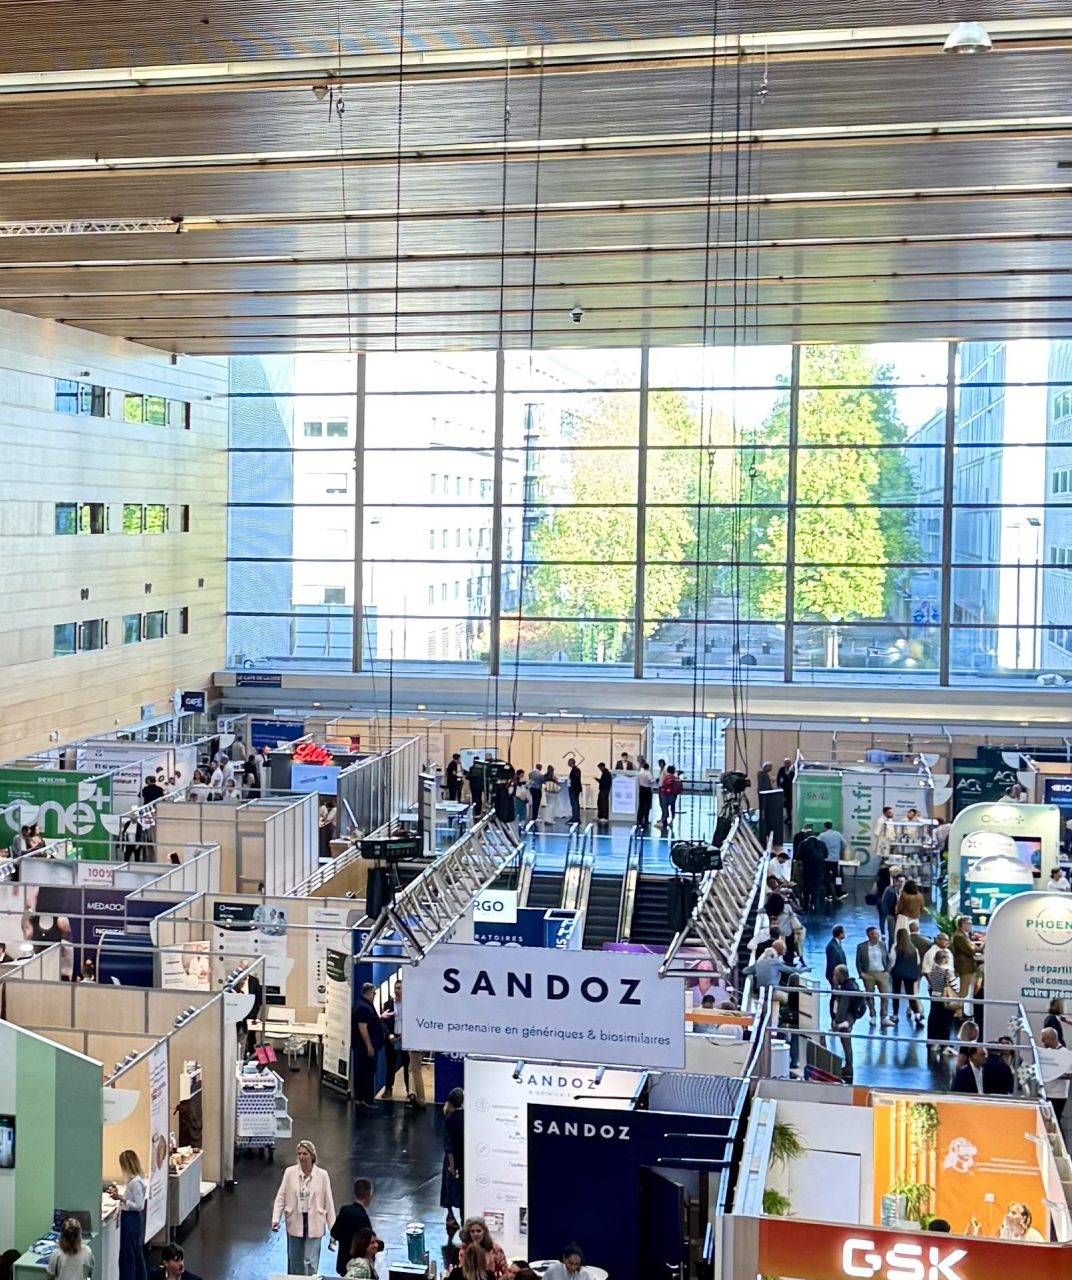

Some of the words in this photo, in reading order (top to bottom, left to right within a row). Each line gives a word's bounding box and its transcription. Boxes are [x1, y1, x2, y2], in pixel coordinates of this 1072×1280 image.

[293, 742, 334, 767] Lilly
[443, 968, 642, 1005] SANDOZ
[416, 1018, 444, 1030] Votre
[447, 1021, 501, 1035] partenaire
[504, 1027, 518, 1036] en
[522, 1025, 584, 1041] génériques
[587, 1030, 597, 1040] &
[600, 1030, 671, 1046] biosimilaires
[533, 1119, 631, 1141] SANDOZ
